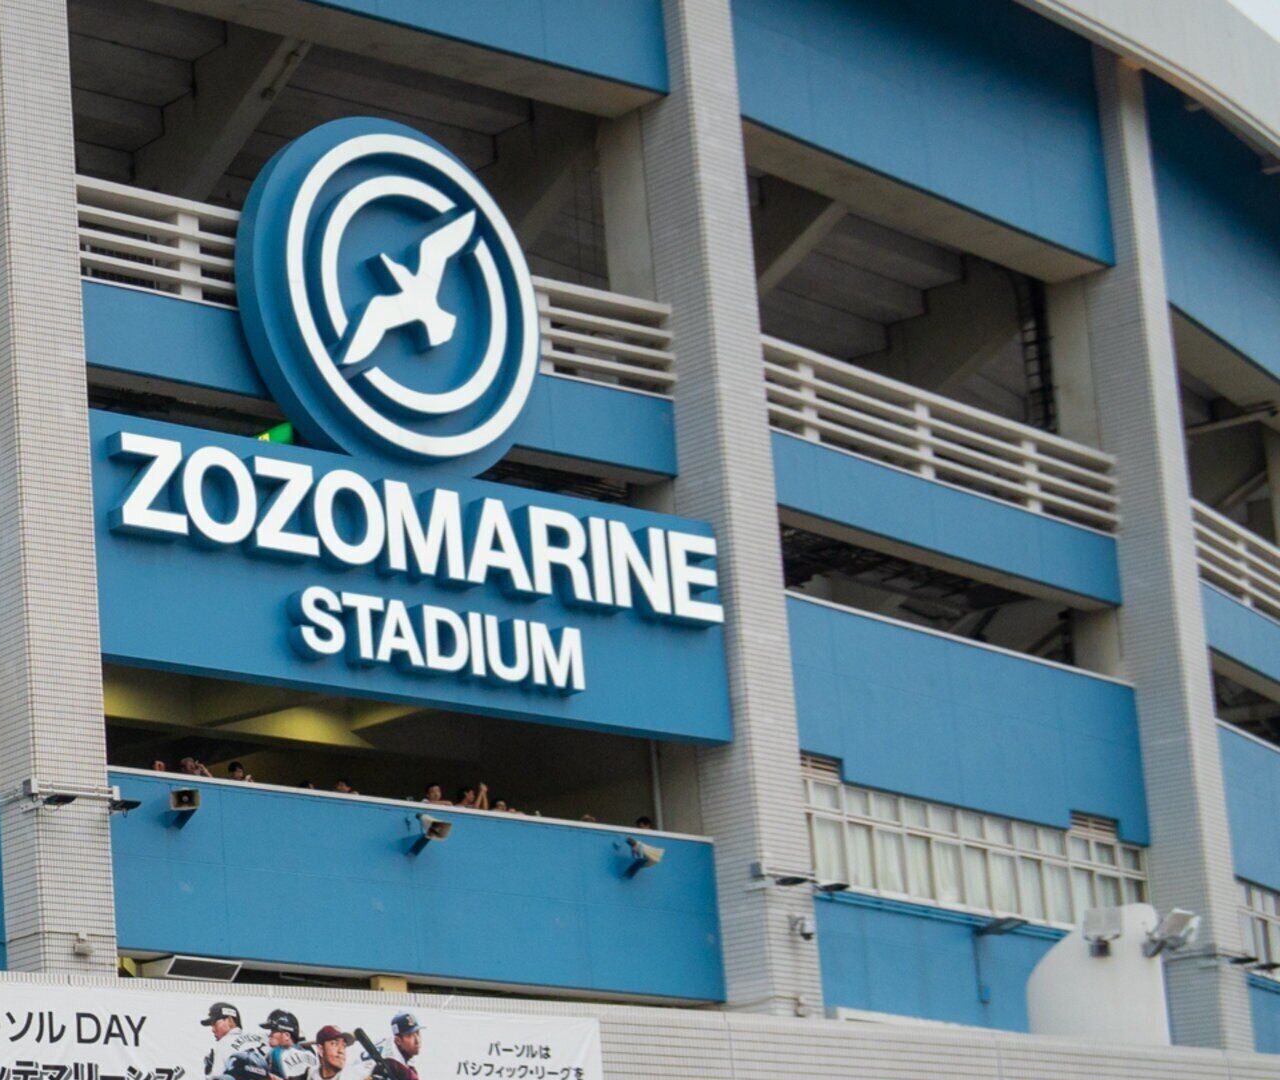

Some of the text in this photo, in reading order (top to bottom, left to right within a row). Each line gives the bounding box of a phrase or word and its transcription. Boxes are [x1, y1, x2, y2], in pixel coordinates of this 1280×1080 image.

[118, 431, 725, 624] ZOZOMARINE
[299, 586, 586, 691] STADIUM
[76, 1012, 147, 1047] DAY
[488, 1042, 552, 1060] パーソルは
